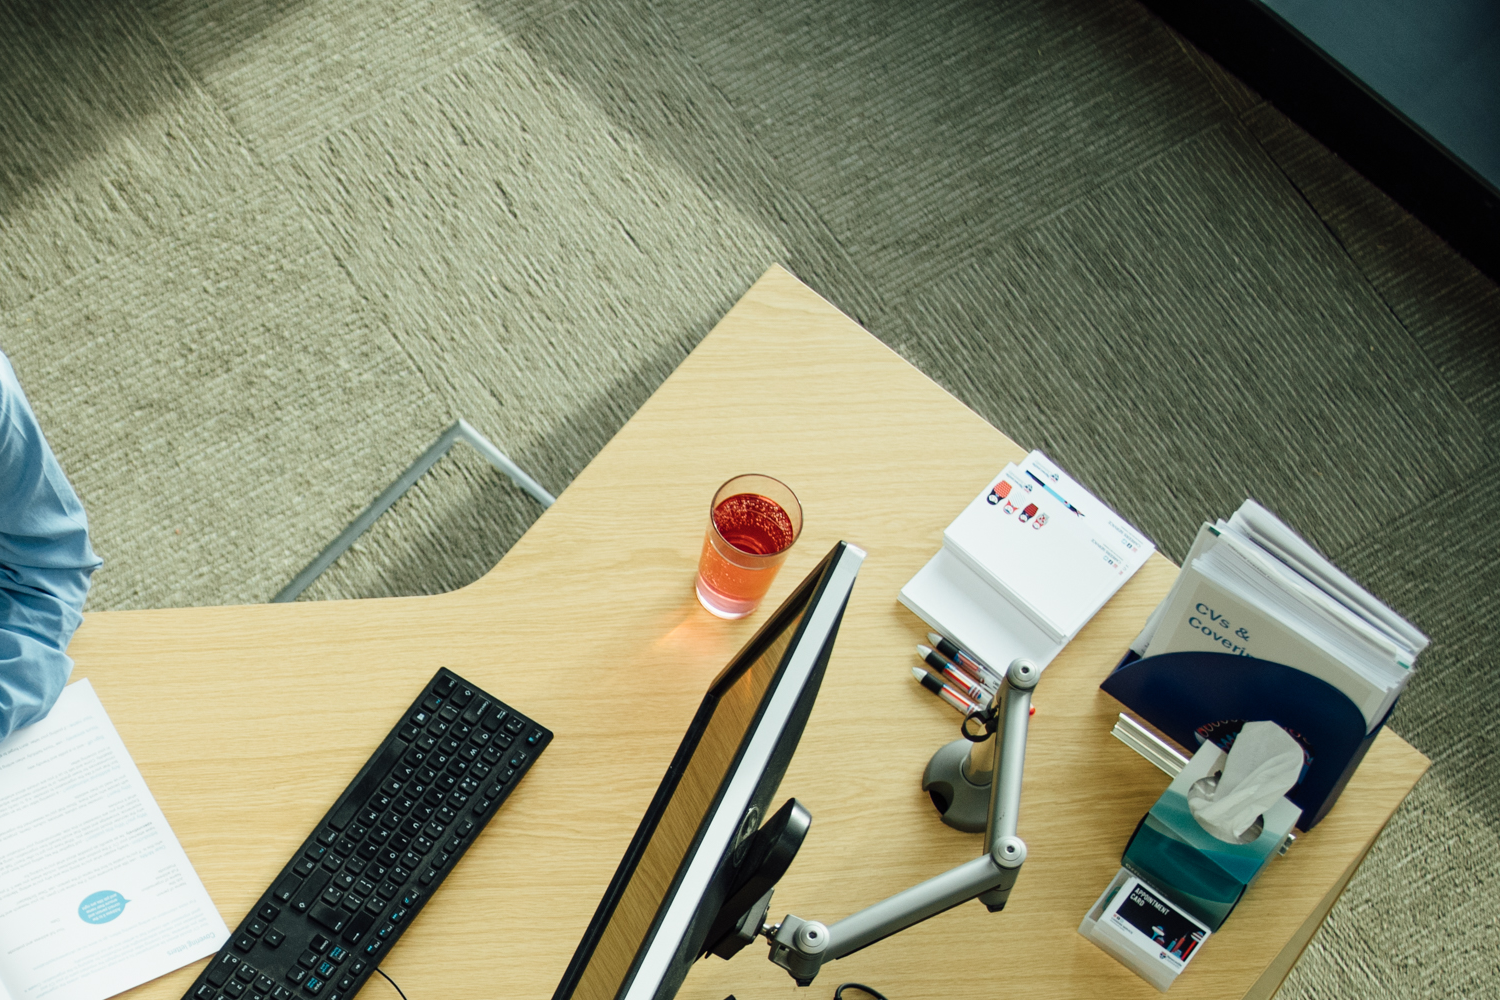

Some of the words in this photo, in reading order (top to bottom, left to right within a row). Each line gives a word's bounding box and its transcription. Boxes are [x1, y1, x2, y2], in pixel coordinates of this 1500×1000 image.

[1195, 603, 1230, 628] CVs
[1235, 627, 1250, 641] &
[1129, 892, 1146, 906] CARD
[1133, 887, 1170, 915] APPOINTMENT
[185, 929, 216, 948] Covering
[165, 942, 187, 957] letters
